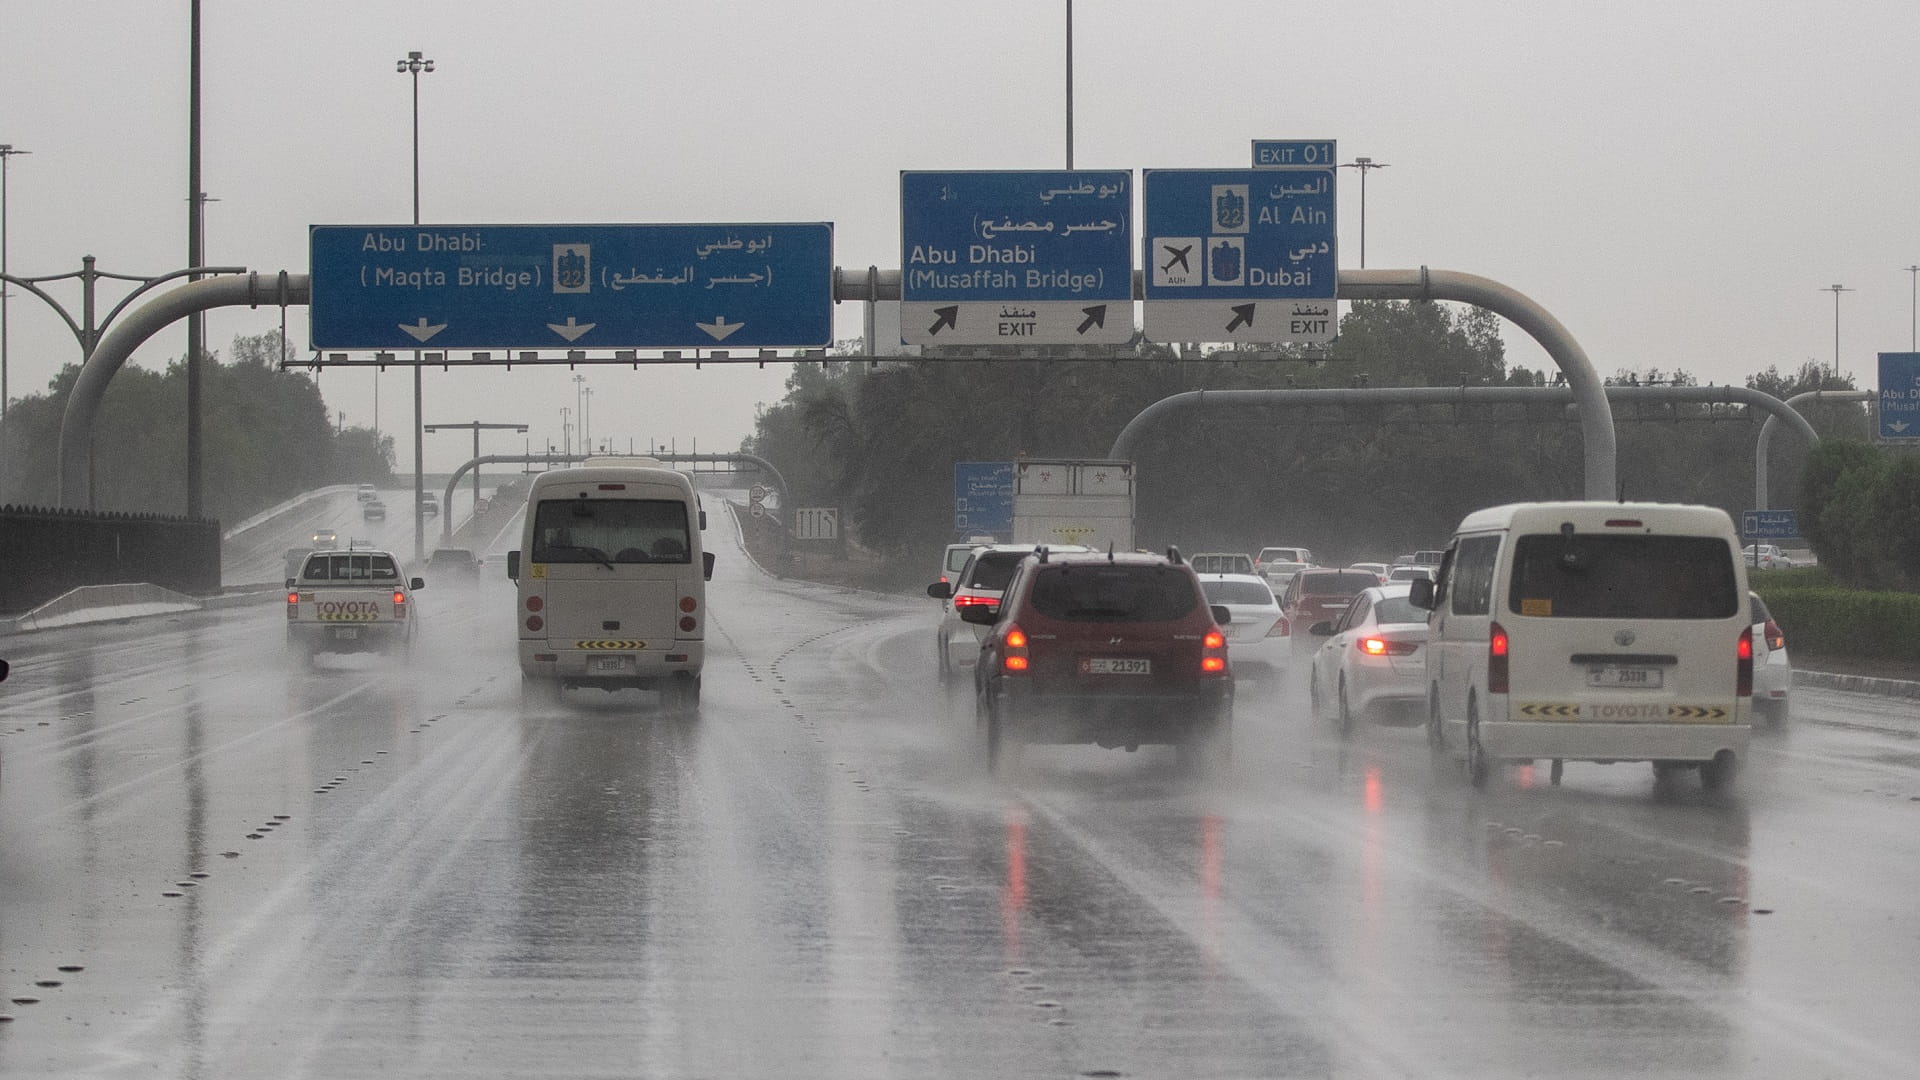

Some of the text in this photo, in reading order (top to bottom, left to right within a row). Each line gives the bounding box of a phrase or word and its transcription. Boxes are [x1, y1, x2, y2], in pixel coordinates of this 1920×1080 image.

[1260, 144, 1330, 163] EXIT 01
[1270, 177, 1327, 199] العين
[1222, 208, 1241, 225] 22
[1258, 206, 1327, 225] Al Ain
[362, 233, 482, 251] Abu Dhabi
[910, 245, 1035, 264] Abu Dhabi
[1289, 240, 1329, 264] دبي
[360, 265, 541, 291] (Maqta Bridge)
[562, 270, 585, 286] 22
[601, 265, 772, 291] (جسر المقطع)
[909, 267, 1103, 292] (Musaffah Bridge)
[1250, 267, 1311, 286] Dubai
[999, 305, 1036, 318] منفذ
[1292, 303, 1329, 316] منفذ
[998, 323, 1036, 336] EXIT
[1290, 321, 1329, 334] EXIT
[1882, 389, 1905, 399] Abu
[314, 601, 379, 614] TOYOTA
[1111, 660, 1147, 673] 21391
[1590, 704, 1662, 718] TOYOTA
